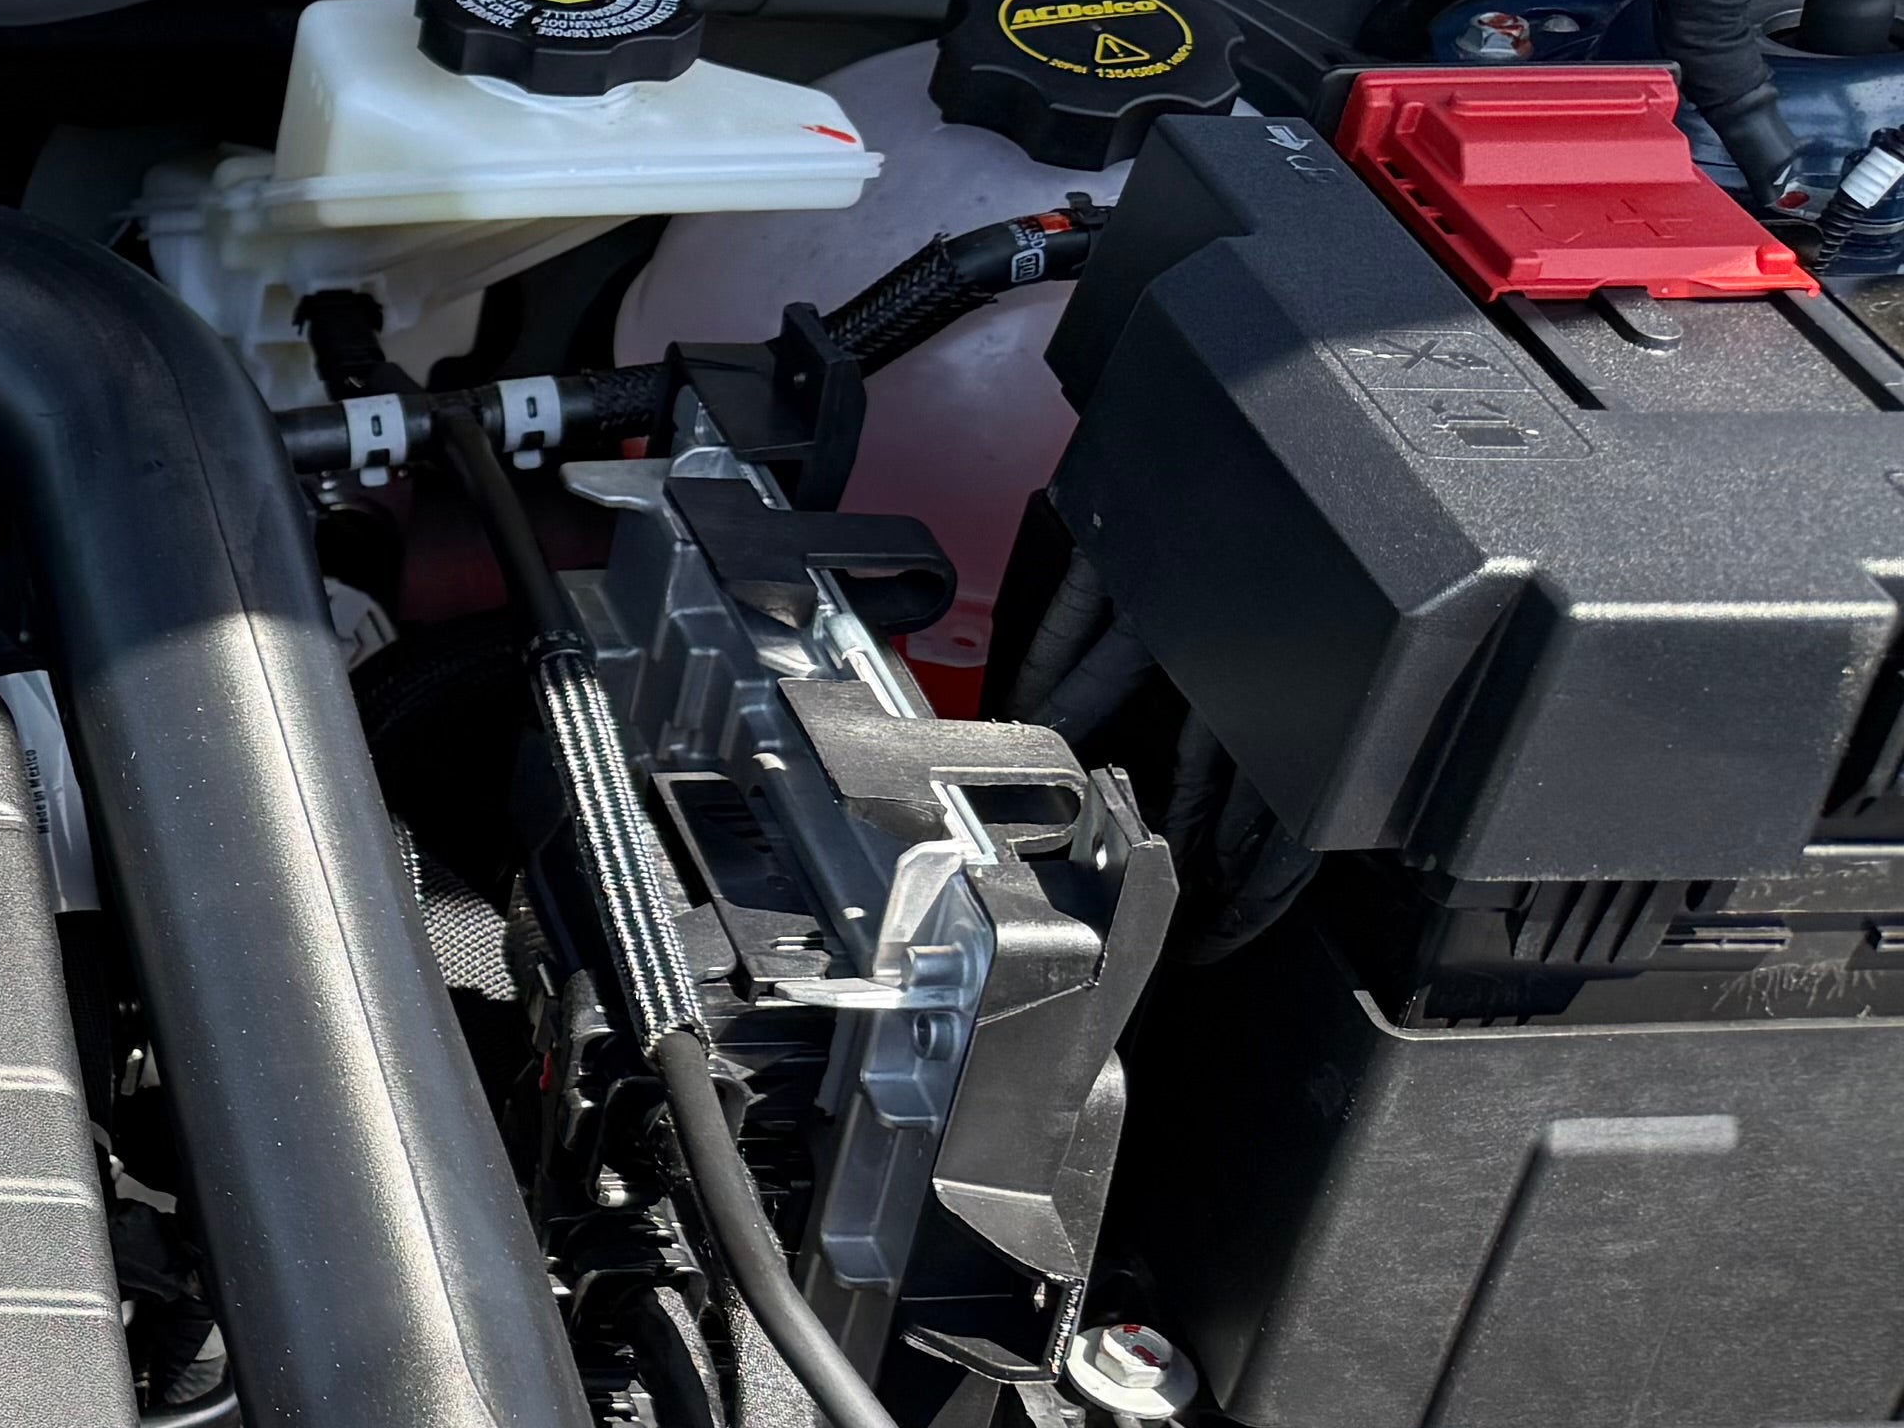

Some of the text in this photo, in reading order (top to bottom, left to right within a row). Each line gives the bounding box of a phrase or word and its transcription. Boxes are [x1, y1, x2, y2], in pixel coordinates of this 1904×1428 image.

[1012, 0, 1159, 24] ACDelco
[24, 749, 40, 789] Mexico
[37, 802, 51, 834] Made
